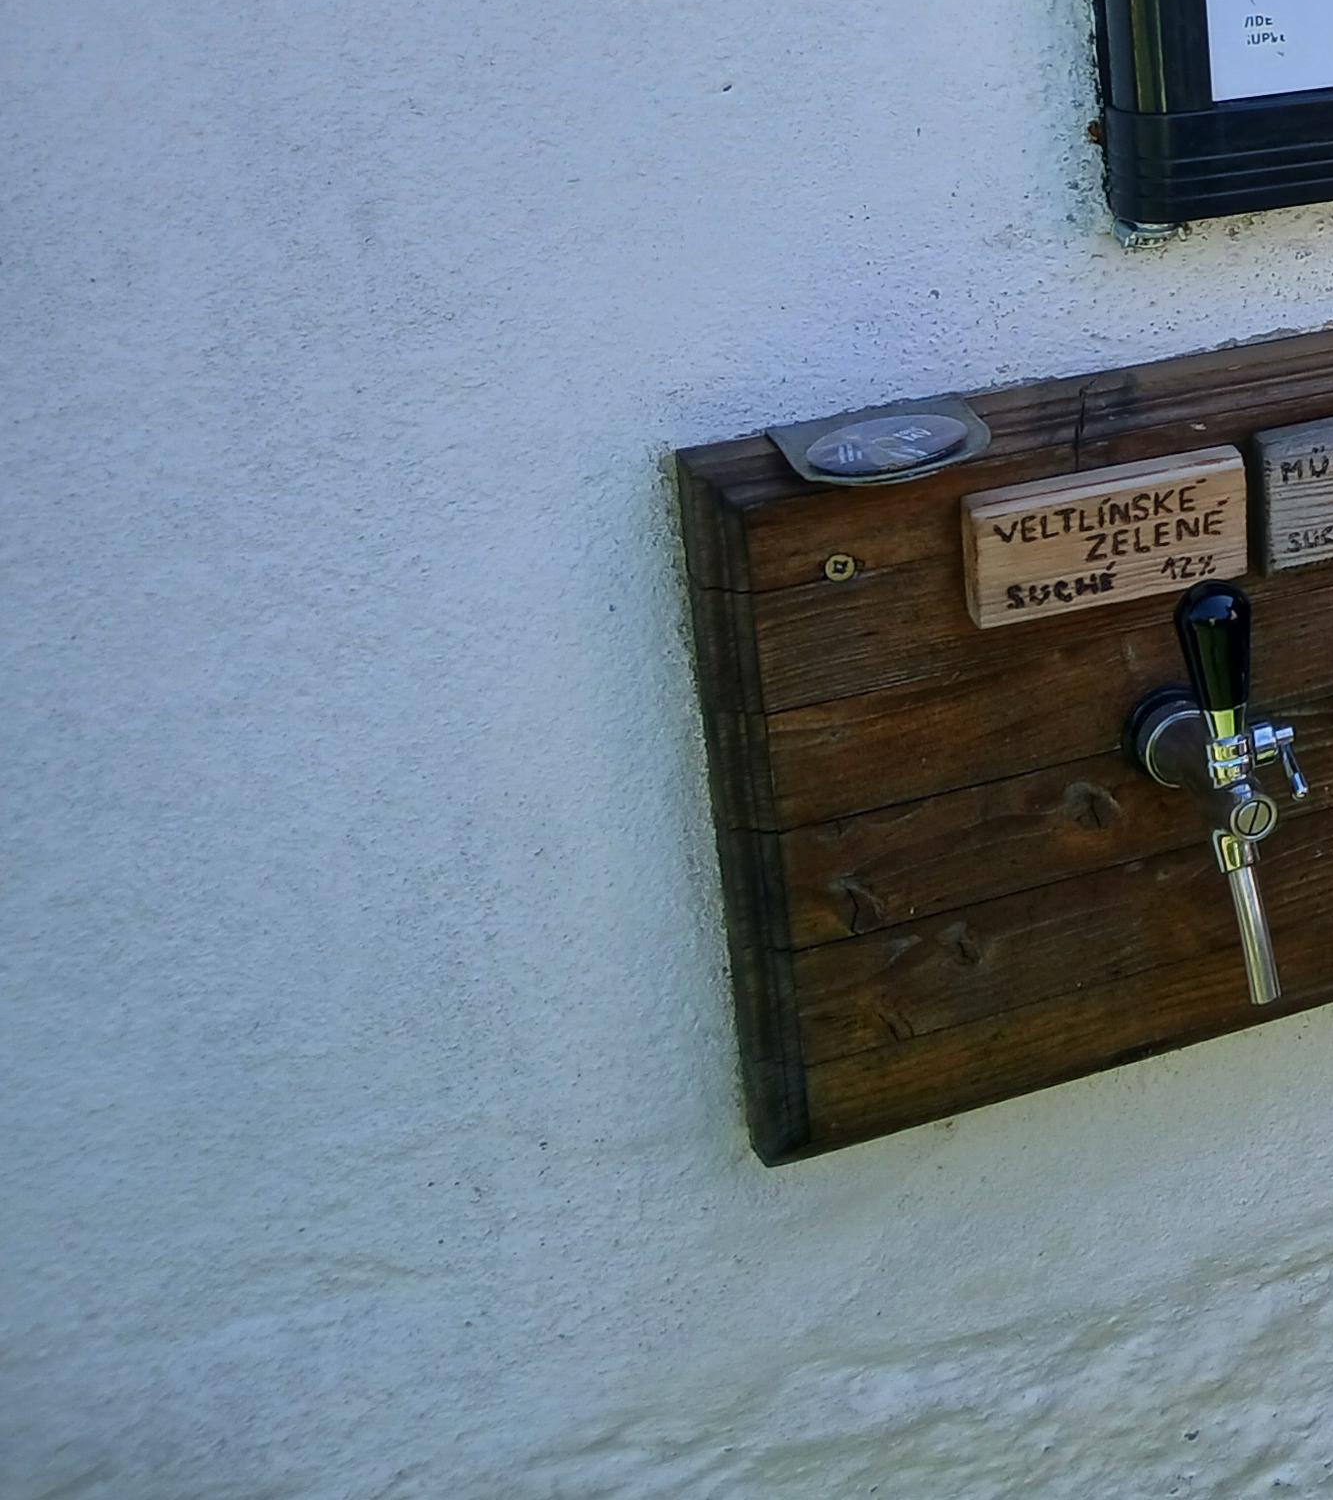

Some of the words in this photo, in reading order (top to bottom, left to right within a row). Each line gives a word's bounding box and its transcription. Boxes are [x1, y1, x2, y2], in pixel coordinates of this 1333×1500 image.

[993, 478, 1207, 543] VELTLÍNSKÉ
[1084, 497, 1231, 563] ZELENÉ
[1006, 561, 1118, 610] SUCHÉ
